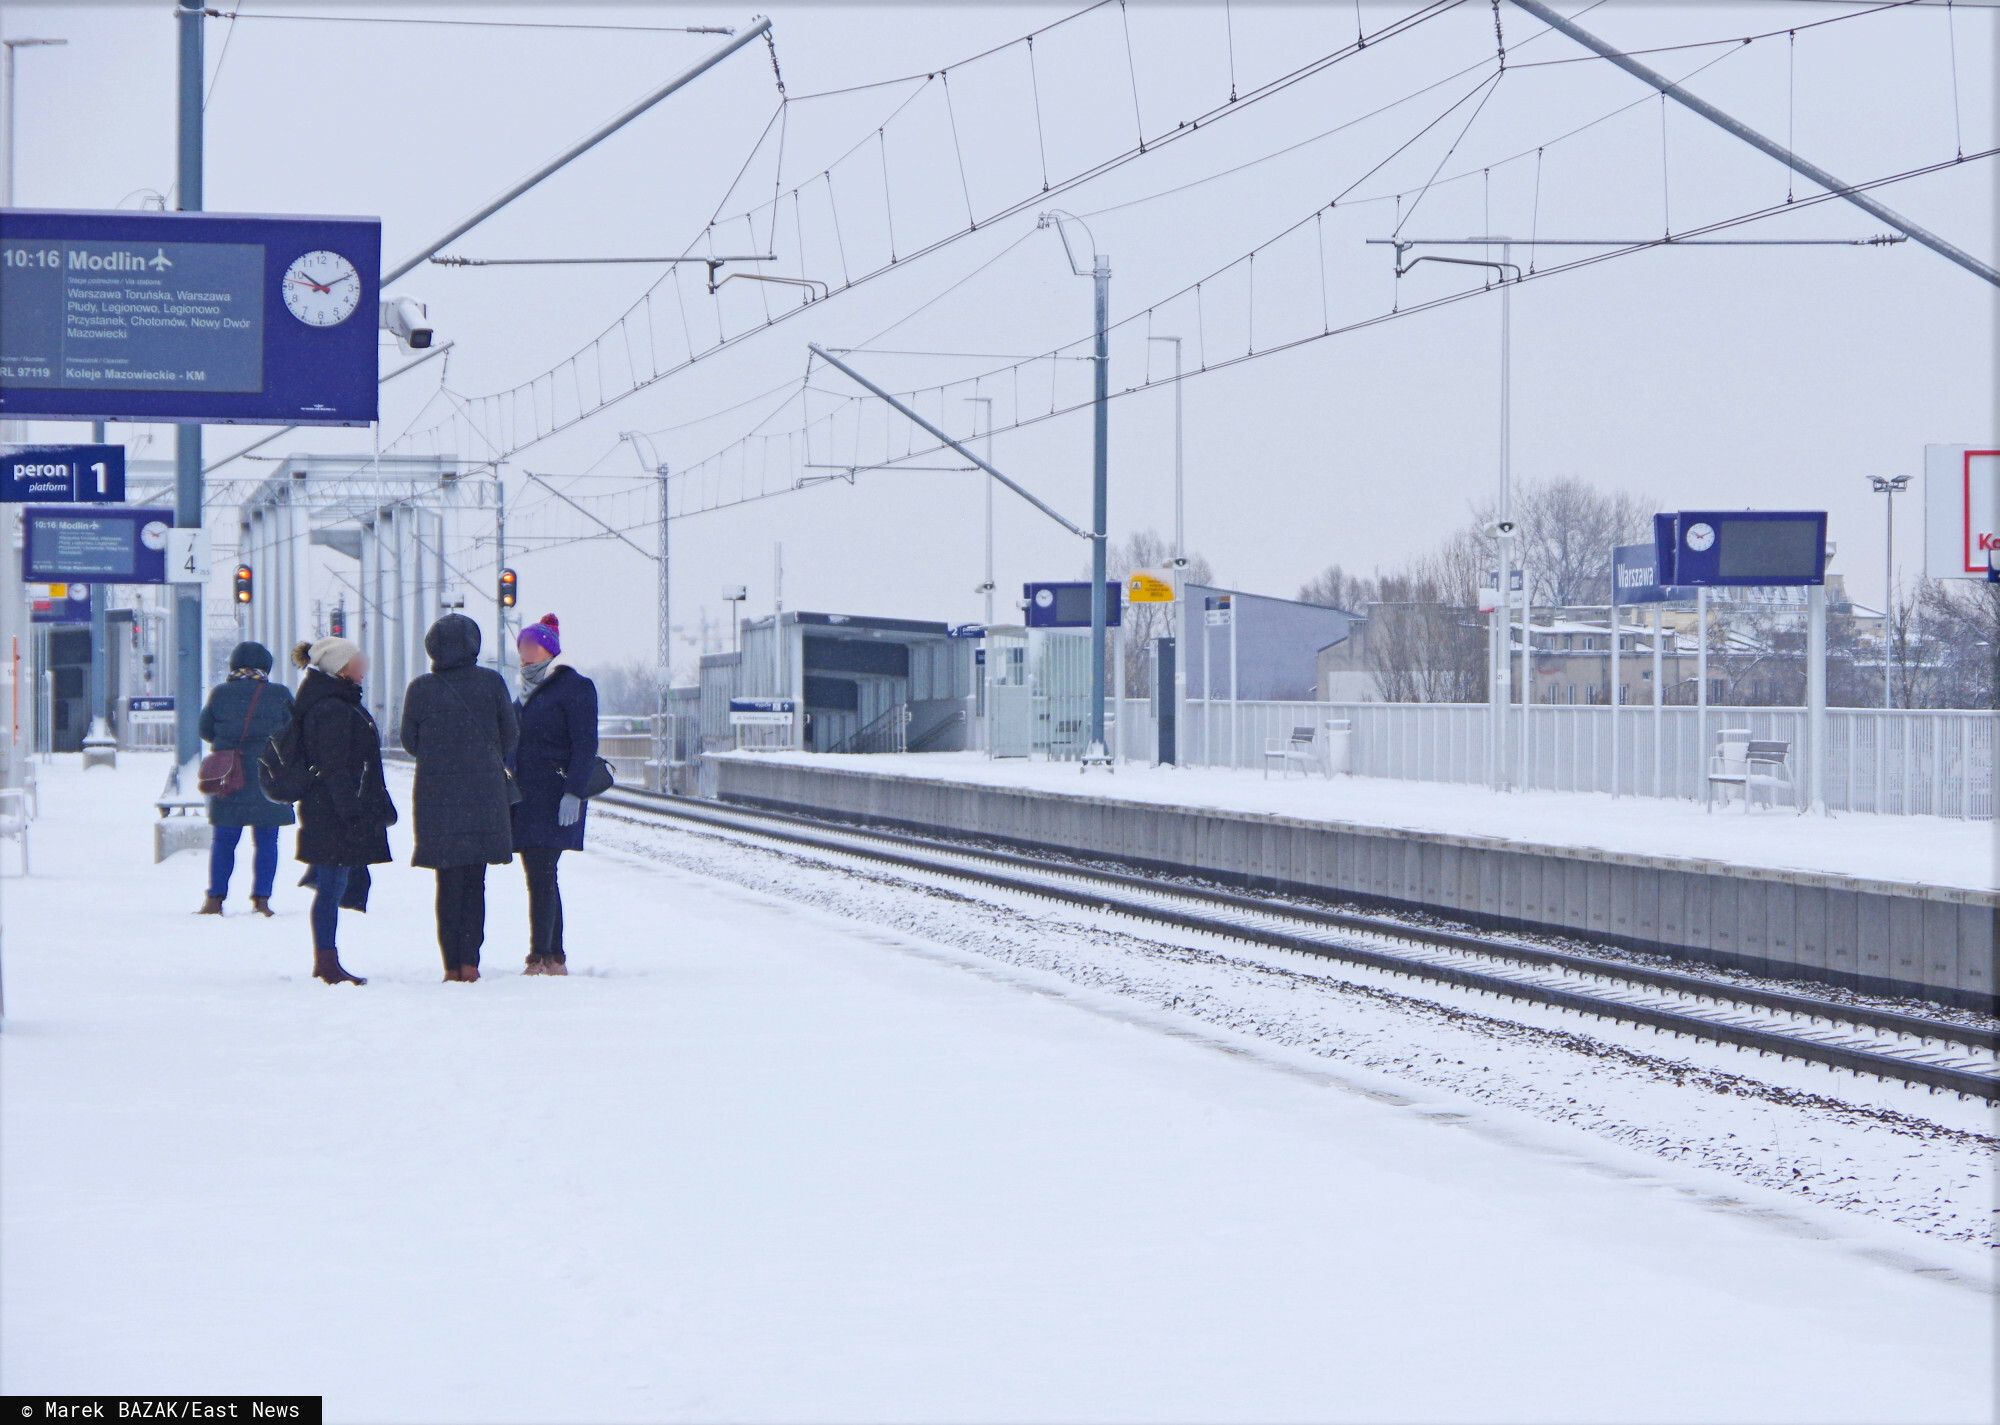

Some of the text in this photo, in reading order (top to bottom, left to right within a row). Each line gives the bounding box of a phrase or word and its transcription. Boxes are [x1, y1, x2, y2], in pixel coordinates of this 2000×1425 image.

[3, 249, 60, 268] 10:16
[68, 250, 146, 271] Modlin
[316, 255, 327, 265] 12
[286, 282, 294, 291] 9
[347, 284, 354, 292] 3
[67, 288, 122, 300] Warszawa
[176, 290, 232, 302] Warszawa
[343, 295, 349, 303] 4
[101, 302, 160, 315] Legionowo,
[163, 303, 220, 316] Legionowo
[317, 311, 324, 320] 6
[191, 317, 220, 330] Nowy
[67, 327, 128, 339] Mazowiecki
[17, 367, 51, 379] 97119
[65, 368, 102, 381] Koleje
[104, 369, 176, 381] Mazowieckie
[185, 370, 205, 381] KM
[13, 461, 106, 493] peron 1
[28, 482, 67, 493] platform
[184, 554, 196, 574] 4
[1617, 563, 1654, 588] Warszawa
